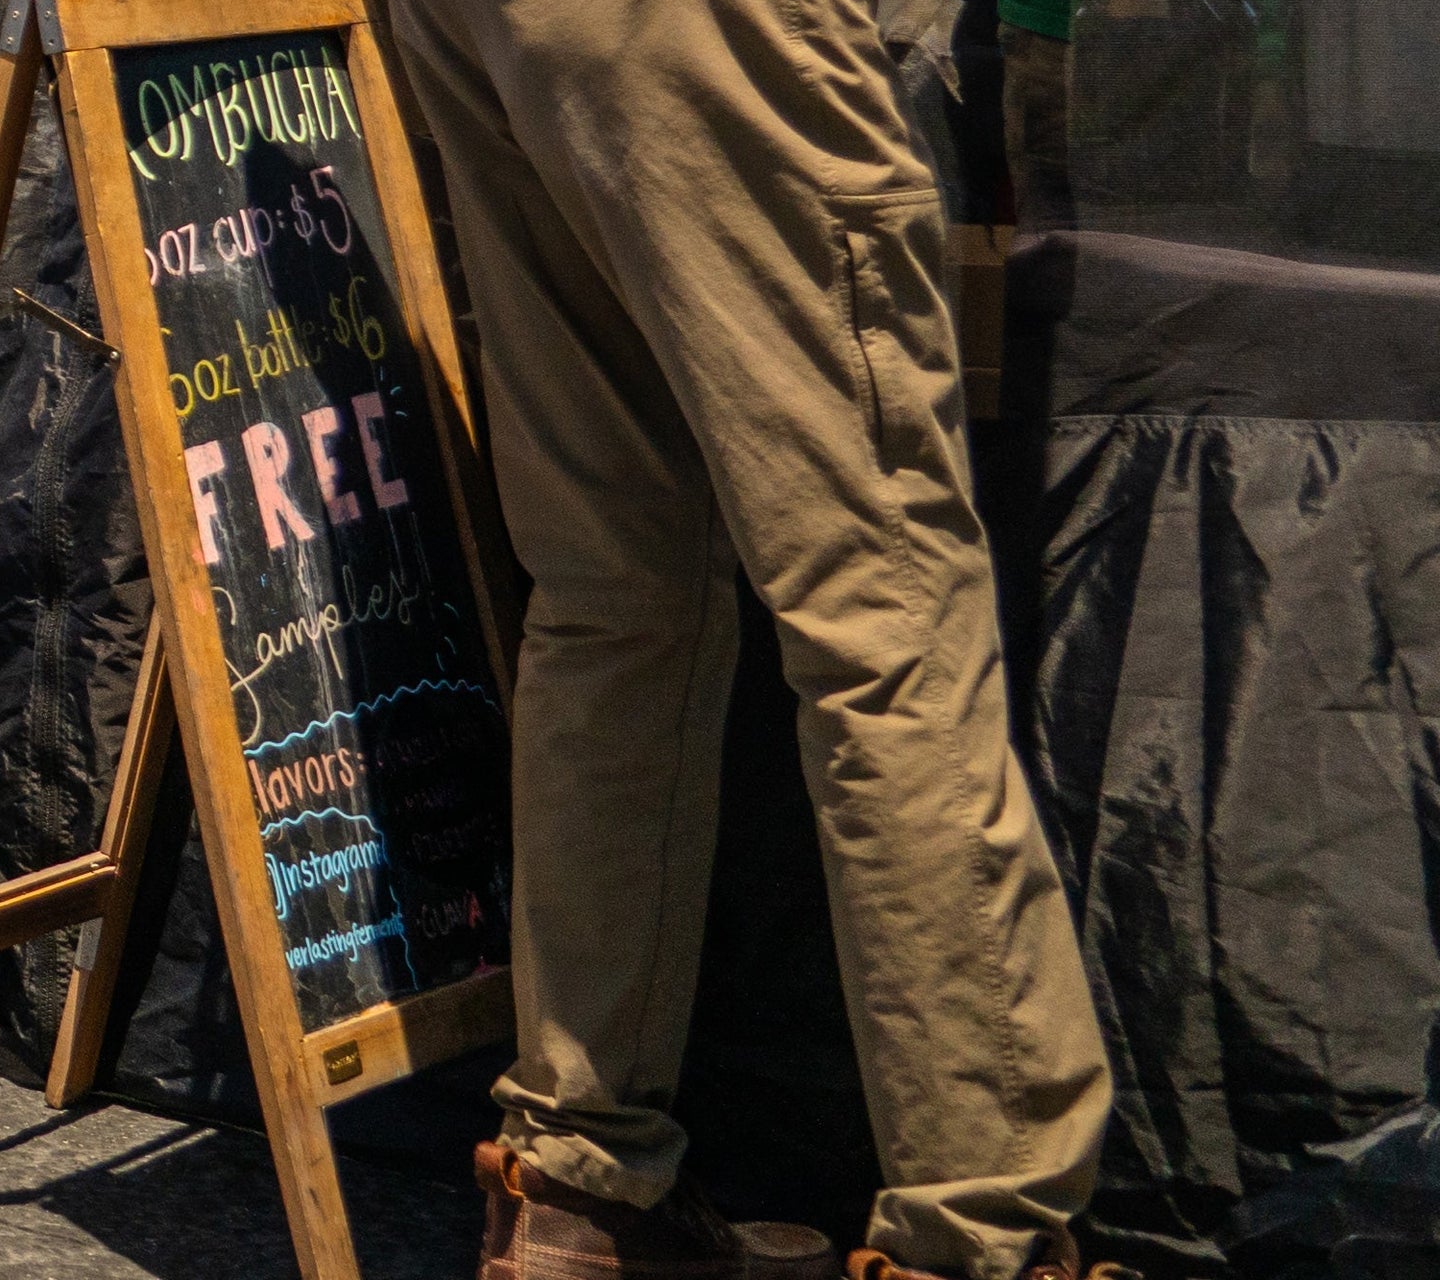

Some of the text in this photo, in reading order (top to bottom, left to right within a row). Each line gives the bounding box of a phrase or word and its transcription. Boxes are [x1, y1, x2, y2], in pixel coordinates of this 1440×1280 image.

[128, 45, 361, 181] OMBUCHA
[291, 165, 352, 256] $5
[184, 391, 410, 565] FREE
[250, 746, 368, 813] lavors:
